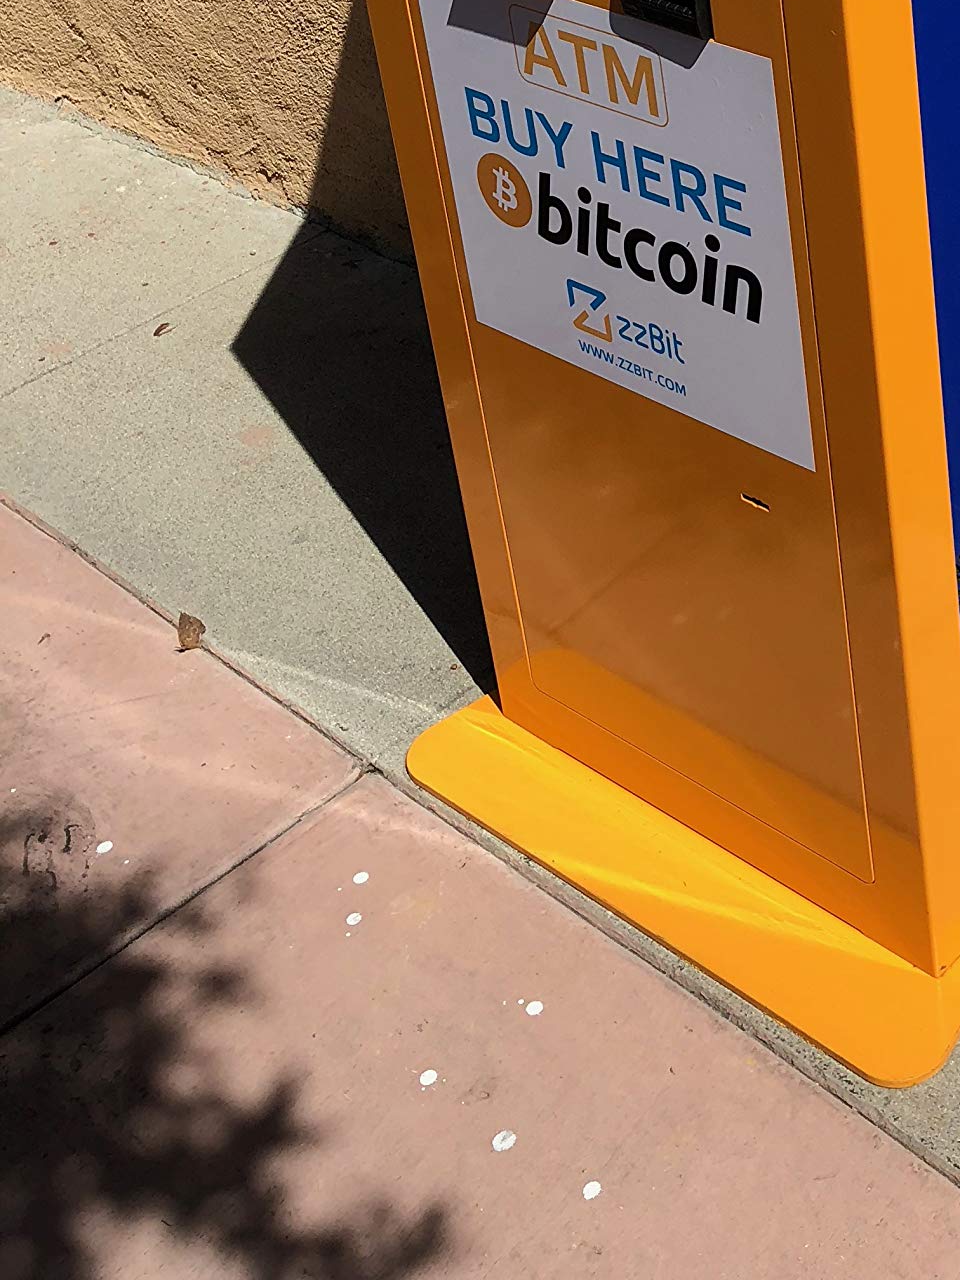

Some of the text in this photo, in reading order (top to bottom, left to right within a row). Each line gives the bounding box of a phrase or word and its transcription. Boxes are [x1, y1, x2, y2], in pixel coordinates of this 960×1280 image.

[522, 19, 660, 119] ATM
[464, 86, 753, 237] BUY HERE
[537, 171, 764, 325] bitcoin
[578, 338, 688, 398] WWW.ZZBIT.COM
[617, 314, 687, 366] zzBit
